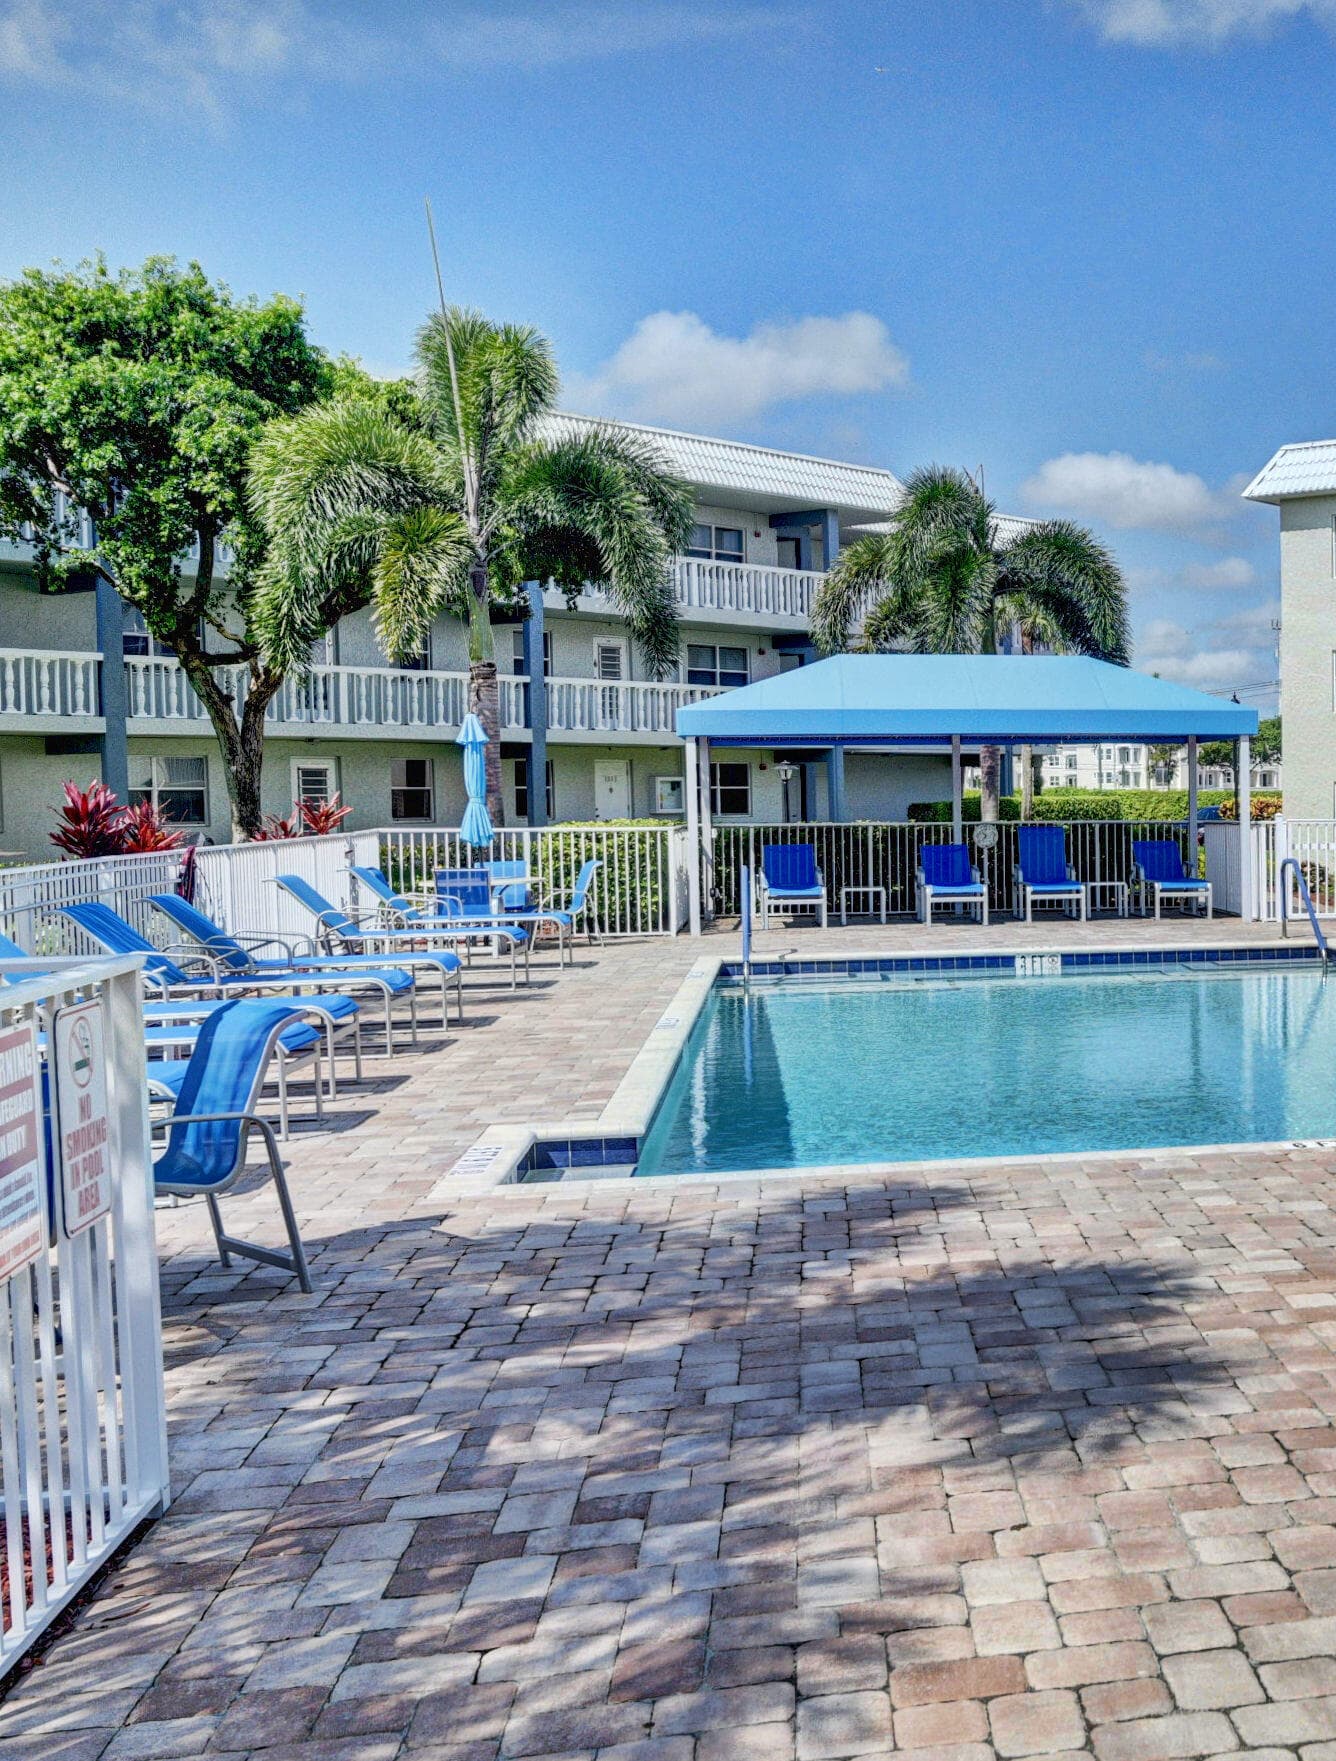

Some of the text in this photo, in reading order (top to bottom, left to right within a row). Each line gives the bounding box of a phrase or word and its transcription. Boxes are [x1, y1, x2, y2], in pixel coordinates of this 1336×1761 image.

[79, 1093, 91, 1122] NO
[66, 1117, 107, 1160] SMOKING
[71, 1161, 80, 1190] IN
[82, 1148, 104, 1183] POOL
[79, 1182, 100, 1217] AREA
